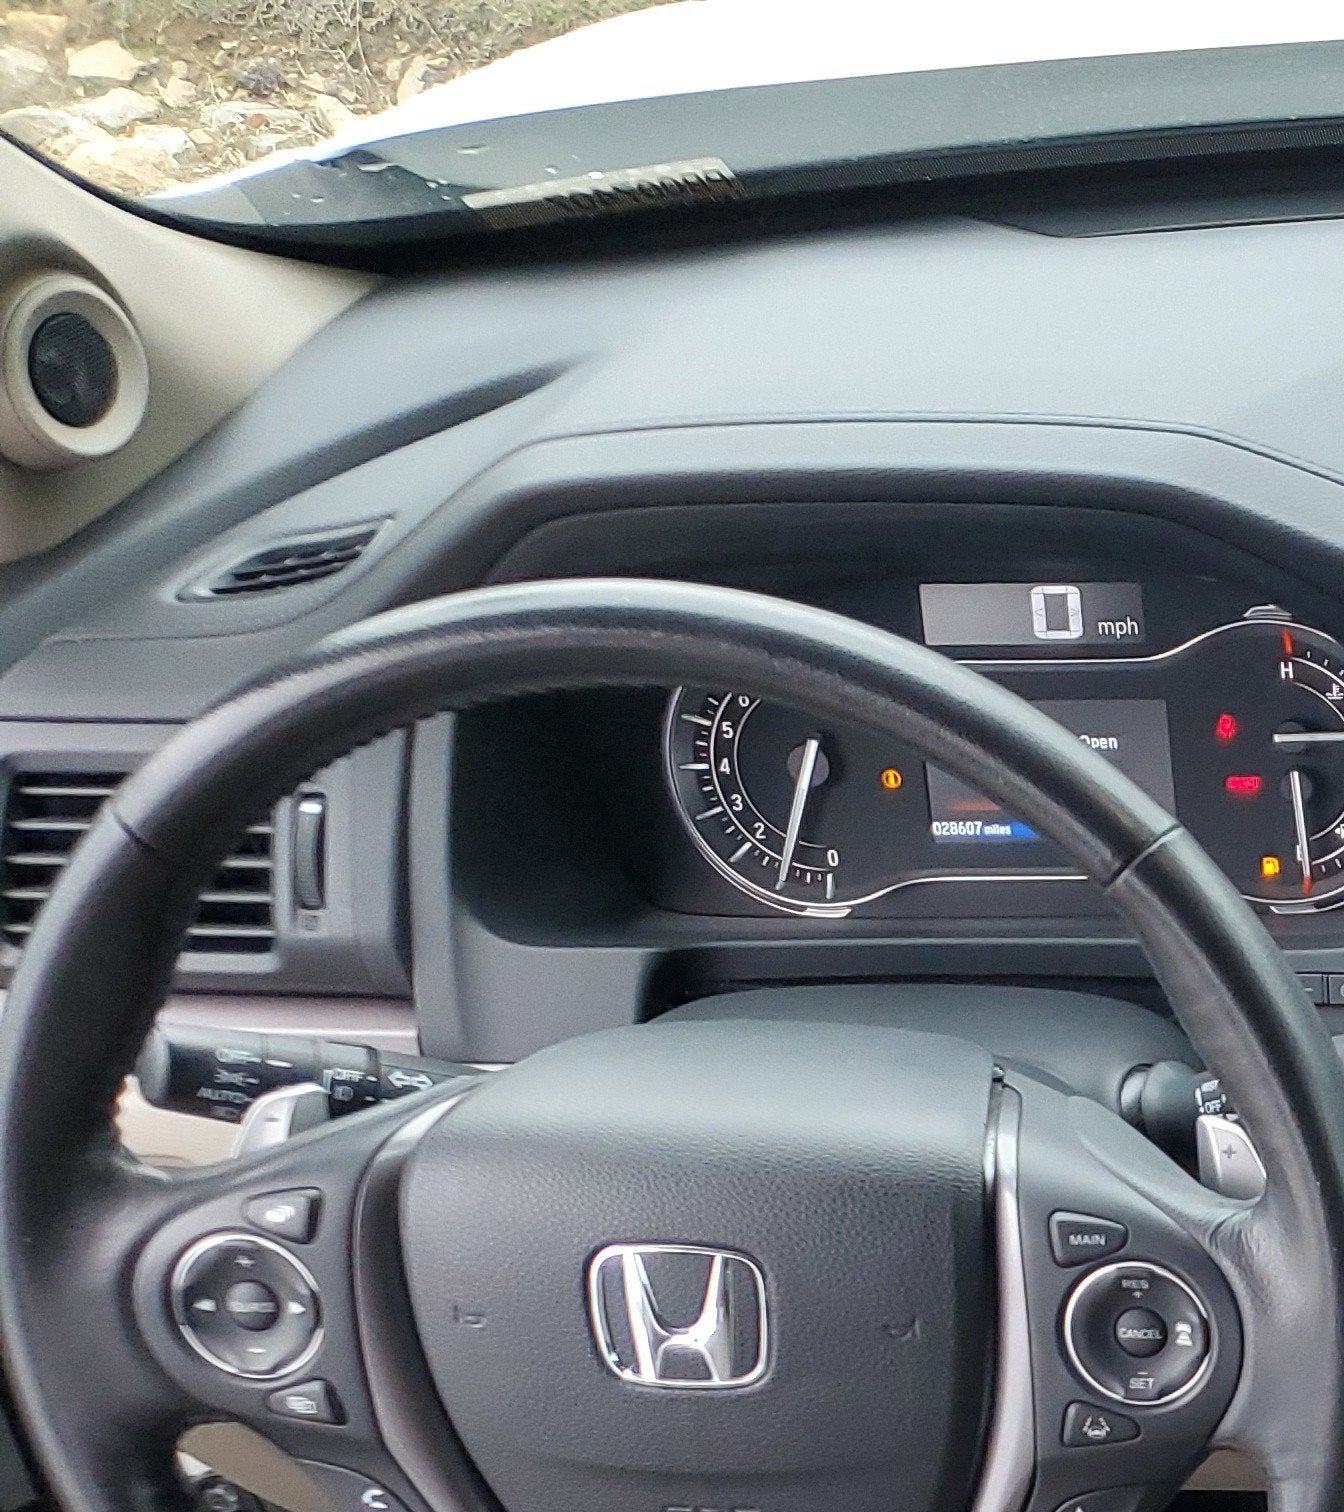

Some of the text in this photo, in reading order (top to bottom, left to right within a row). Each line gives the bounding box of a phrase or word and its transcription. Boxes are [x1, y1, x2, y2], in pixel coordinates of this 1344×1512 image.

[1097, 615, 1140, 639] mph
[1280, 661, 1294, 680] H
[721, 721, 734, 739] 5
[1079, 734, 1119, 750] Open
[719, 757, 731, 775] 4
[730, 793, 743, 811] 3
[753, 822, 767, 839] 2
[931, 820, 1012, 836] 028607 miles
[826, 849, 839, 867] 0
[1068, 1233, 1106, 1246] MAIN
[1118, 1328, 1163, 1339] CANCEL
[1129, 1377, 1155, 1389] SET
